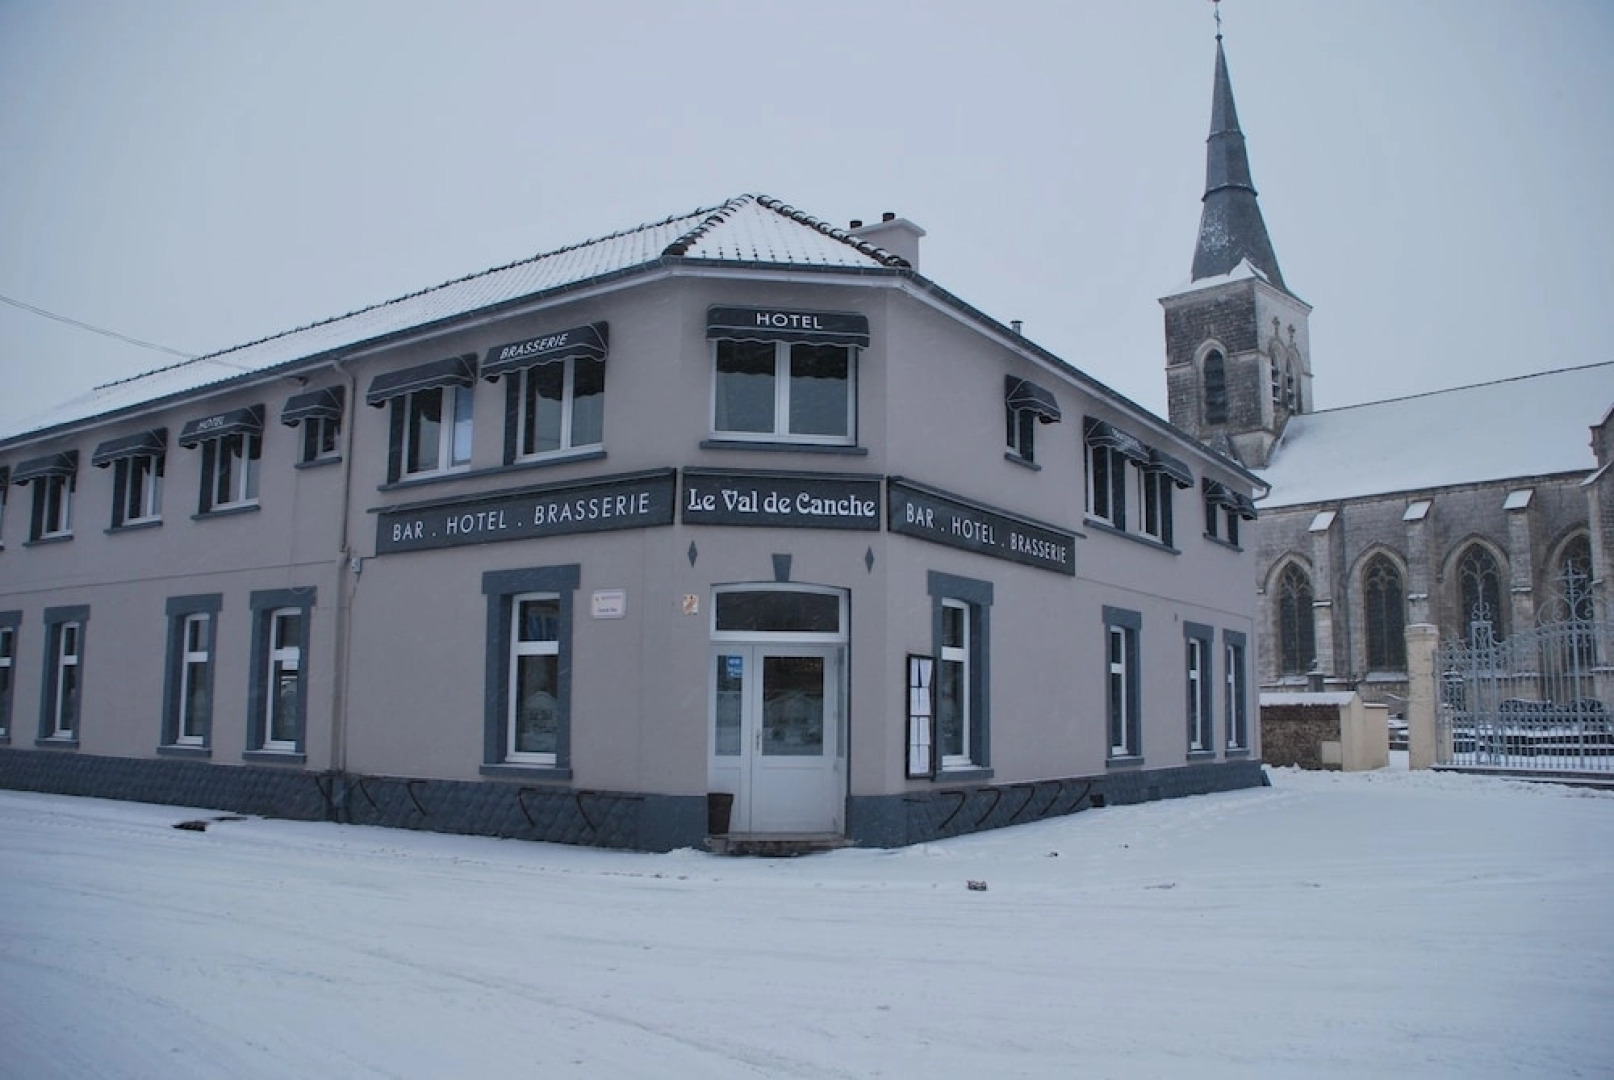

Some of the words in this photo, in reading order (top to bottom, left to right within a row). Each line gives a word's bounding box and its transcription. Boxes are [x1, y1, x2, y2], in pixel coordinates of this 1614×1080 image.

[756, 312, 823, 329] HOTEL
[499, 332, 569, 360] BRASSERIE
[393, 521, 423, 541] BAR
[447, 510, 507, 535] HOTEL
[534, 493, 649, 525] BRASSERIE
[687, 488, 716, 511] Le
[721, 489, 758, 513] Val
[763, 491, 791, 514] de
[795, 493, 875, 517] Canche
[906, 502, 934, 529] BAR
[952, 516, 996, 545] HOTEL
[1010, 532, 1067, 564] BRASSERIE
